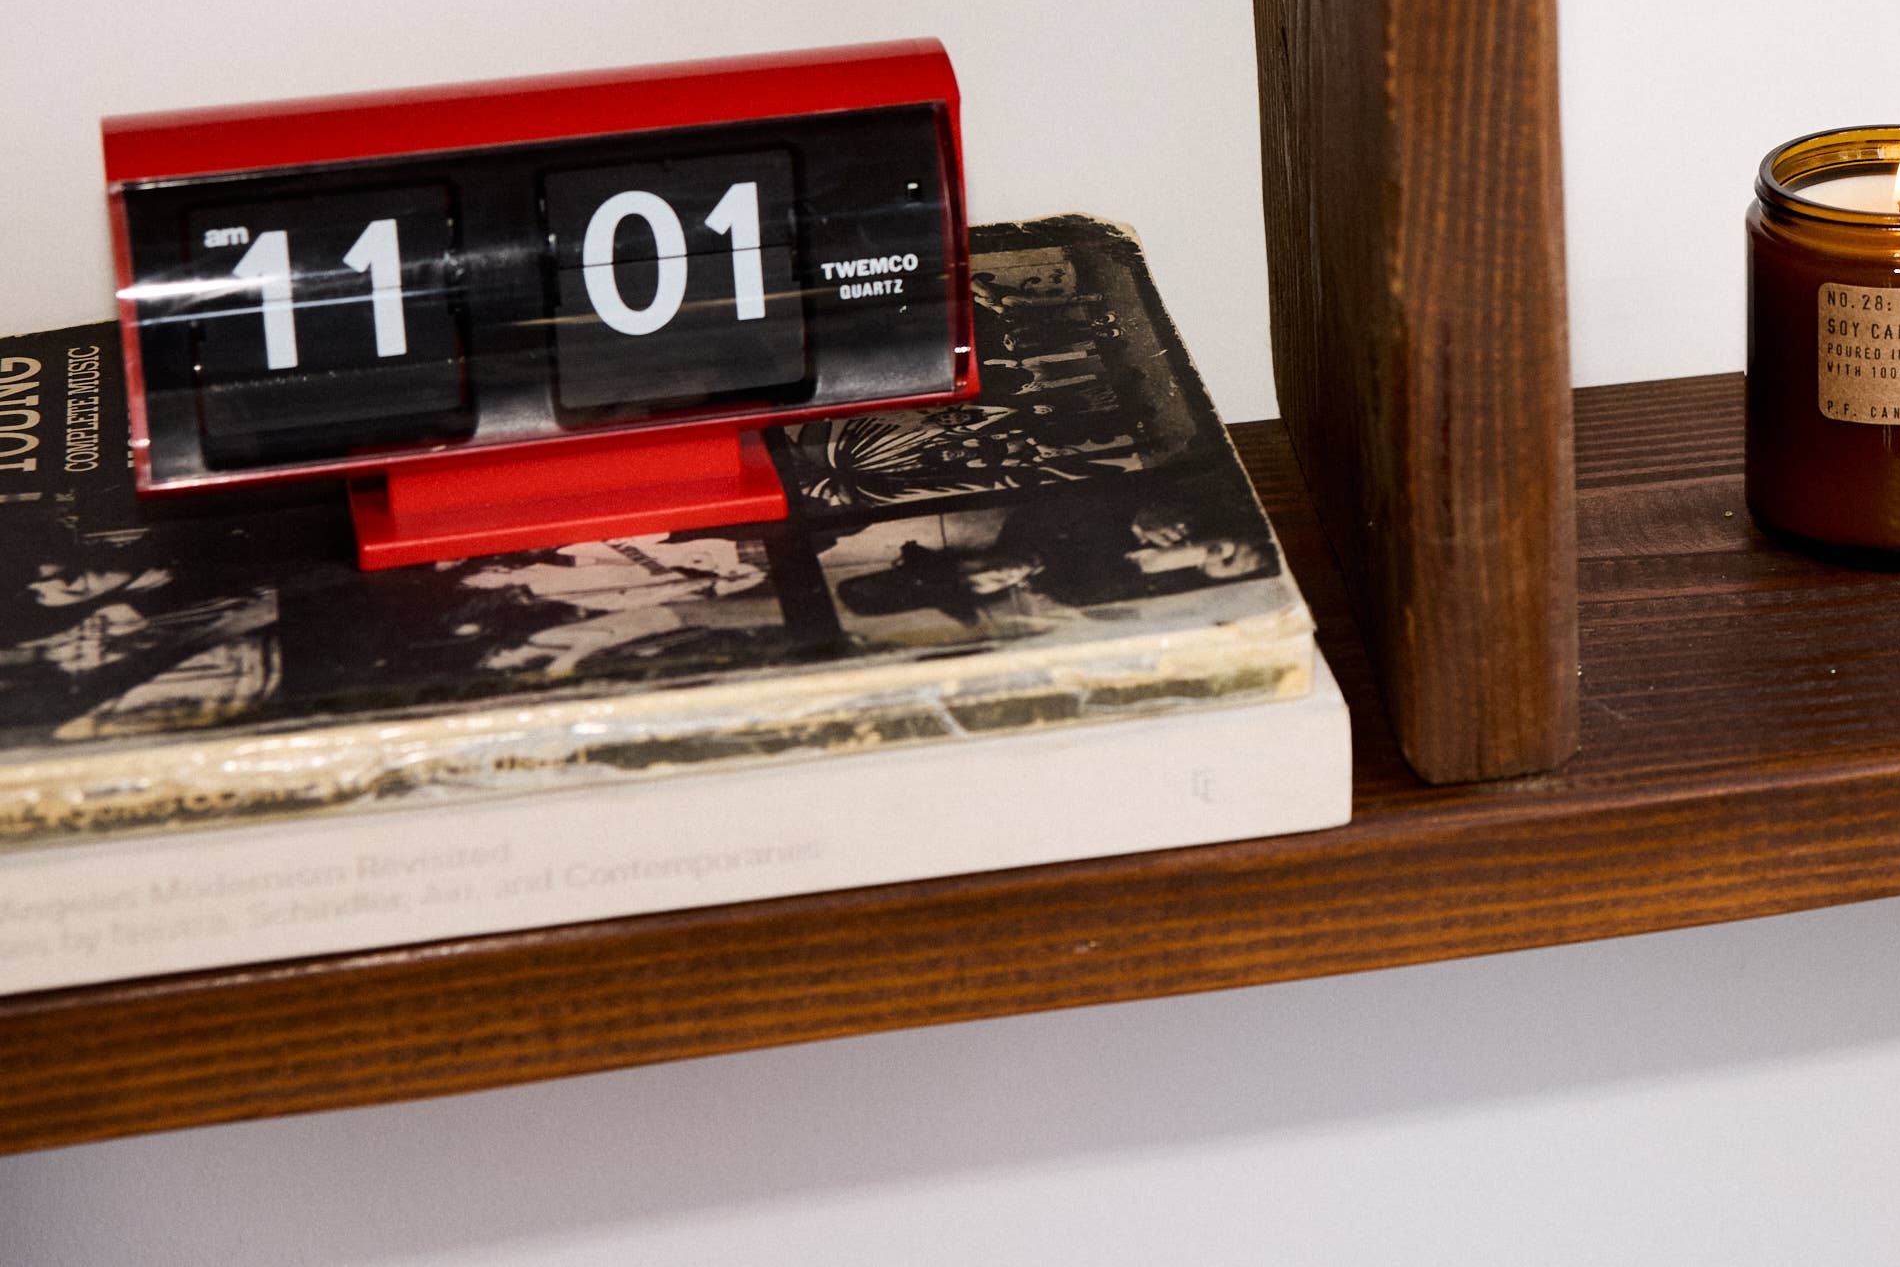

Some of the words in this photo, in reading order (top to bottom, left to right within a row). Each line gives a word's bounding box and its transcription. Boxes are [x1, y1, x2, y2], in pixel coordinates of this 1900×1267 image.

[203, 224, 250, 248] am
[233, 218, 408, 371] 11
[581, 181, 766, 337] 01
[821, 253, 919, 282] TWEMCO
[838, 278, 904, 301] QUARTZ
[1827, 318, 1860, 338] SOY
[1827, 342, 1881, 361] POURED
[67, 345, 100, 395] MUSIC
[1827, 362, 1862, 378] WITH
[1827, 399, 1858, 416] P.F.
[64, 396, 100, 473] COMPLETE
